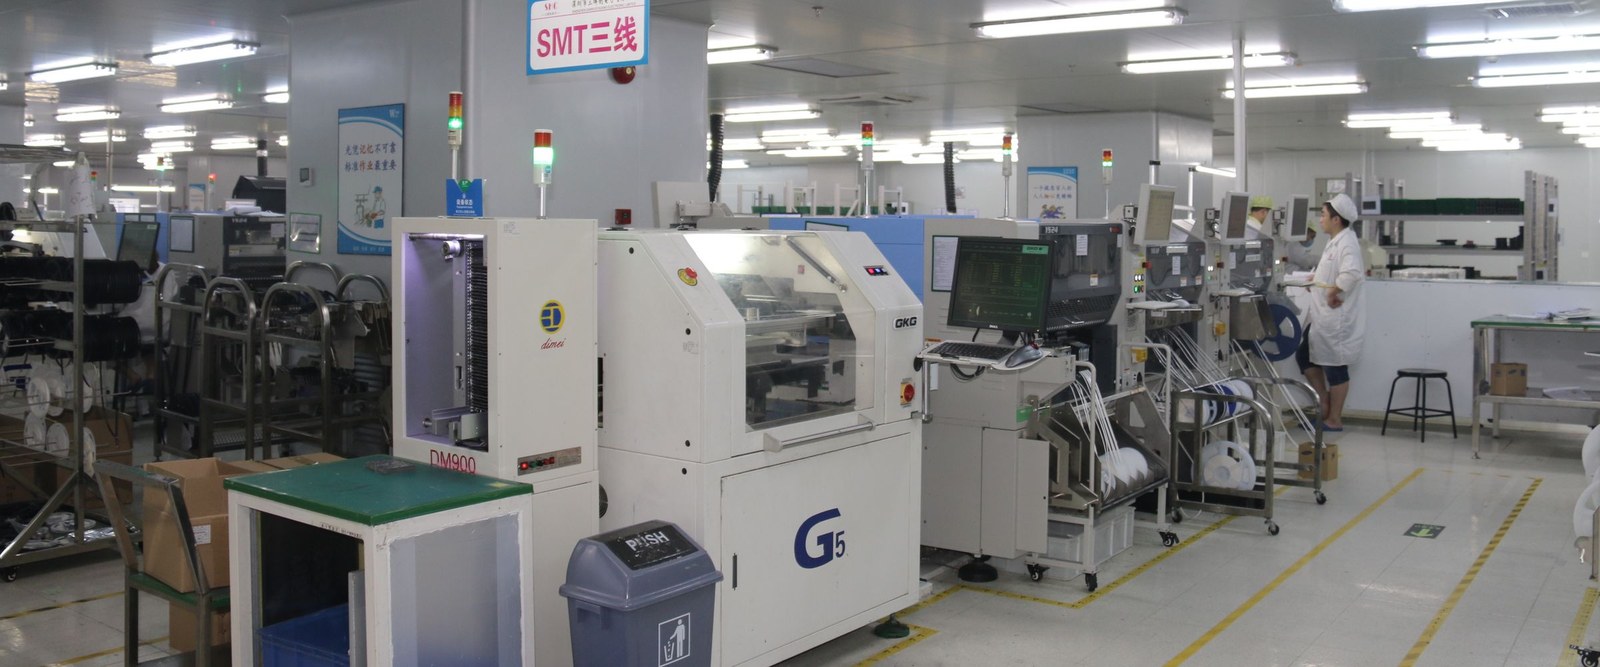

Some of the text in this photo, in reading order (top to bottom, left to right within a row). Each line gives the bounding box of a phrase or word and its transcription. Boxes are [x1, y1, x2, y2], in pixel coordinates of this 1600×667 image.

[537, 16, 638, 58] SMT三线
[345, 159, 397, 172] 标准作业最重要
[895, 316, 917, 329] GKG
[540, 337, 567, 350] dimei
[430, 449, 476, 475] DM900
[624, 531, 670, 551] PUSH
